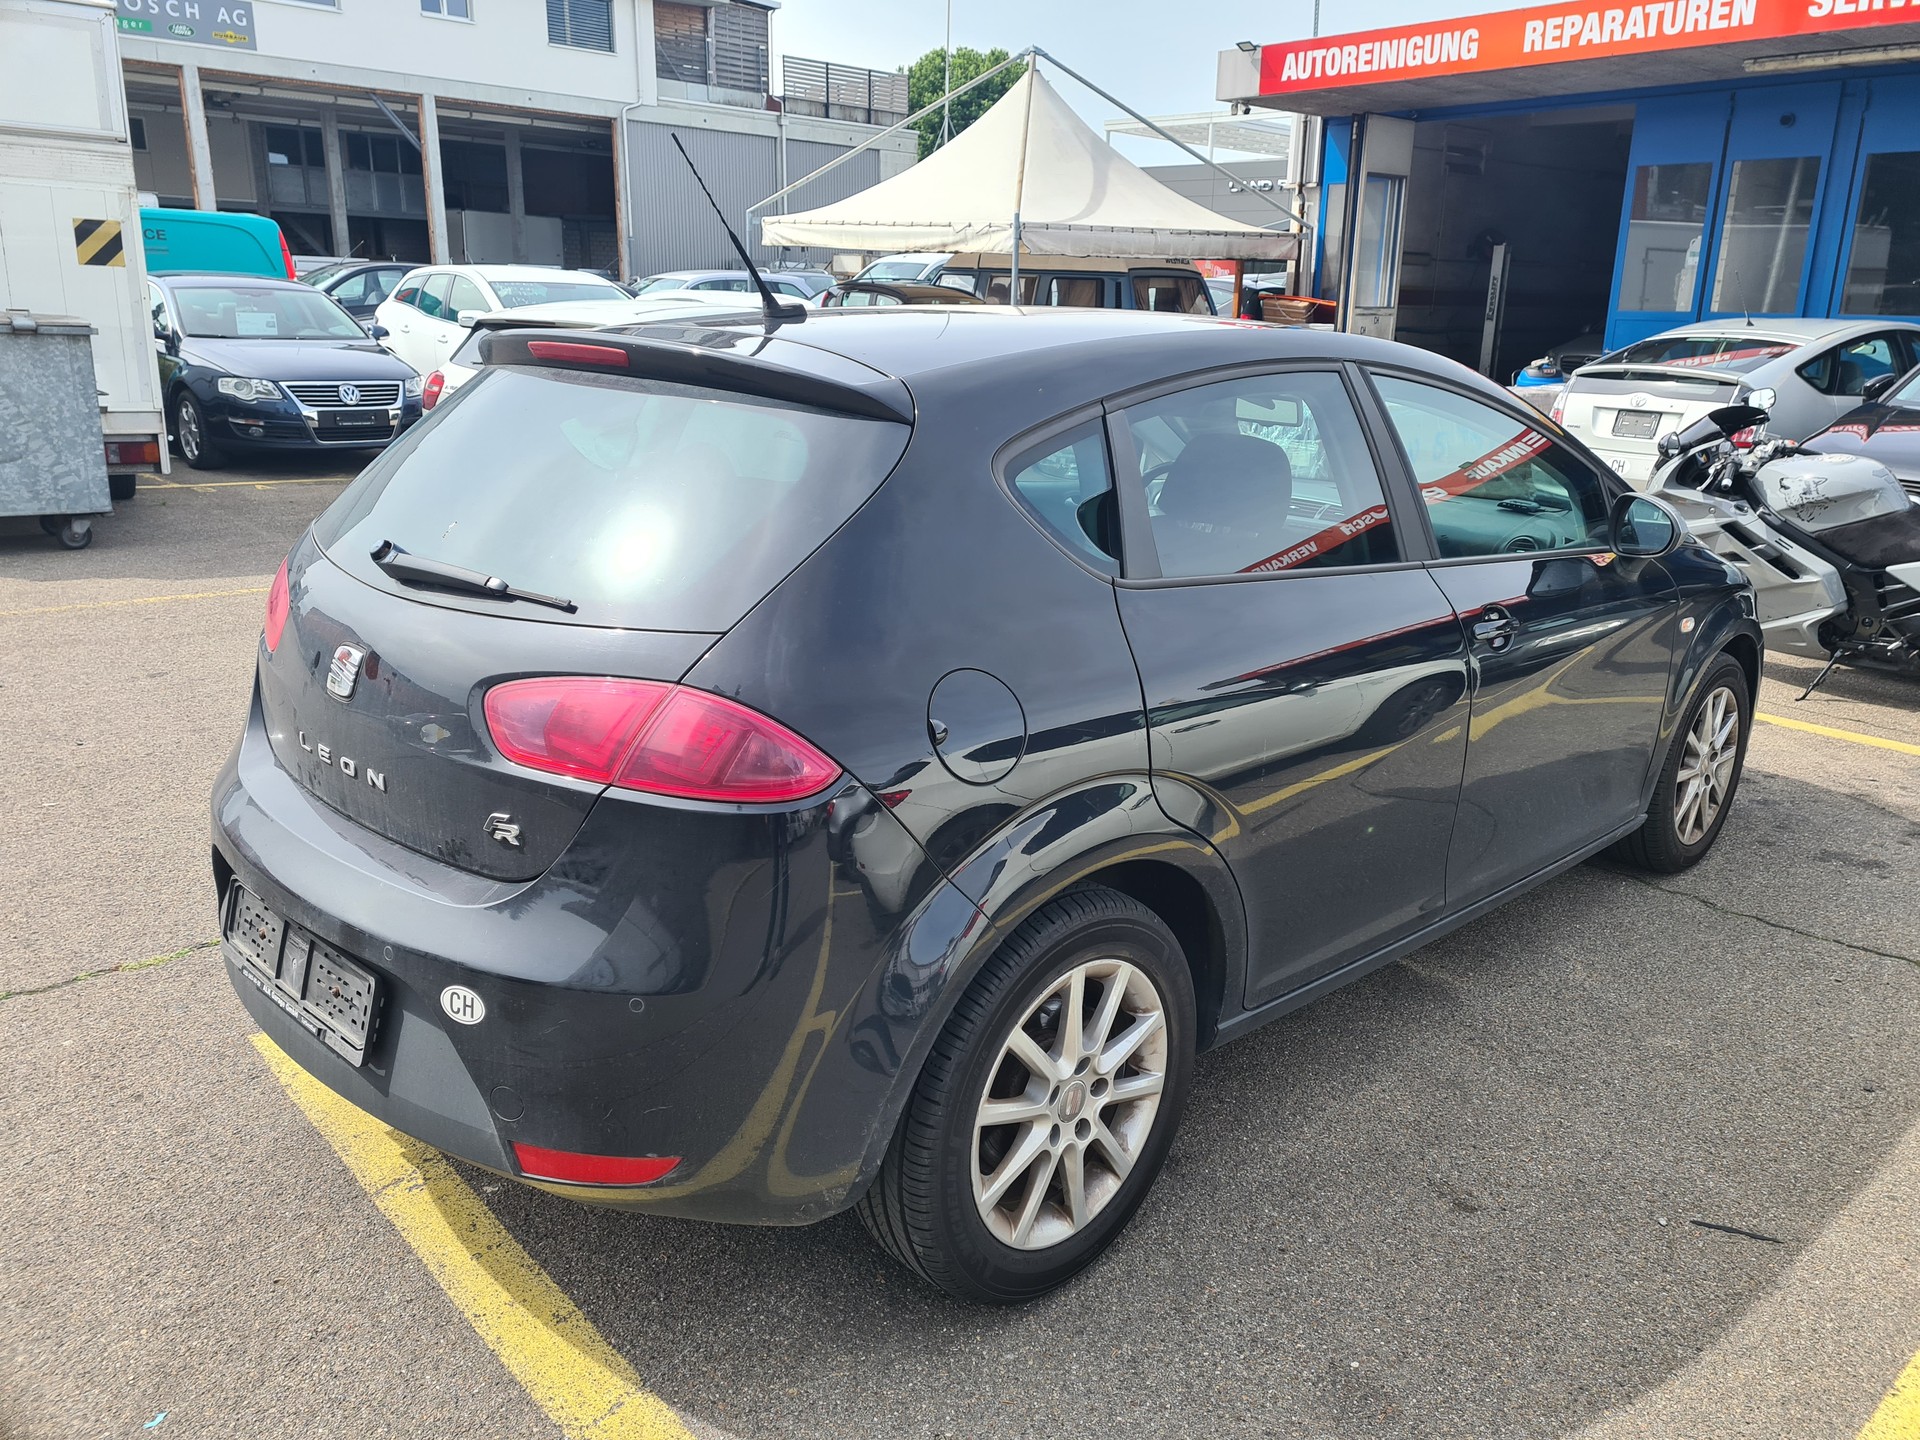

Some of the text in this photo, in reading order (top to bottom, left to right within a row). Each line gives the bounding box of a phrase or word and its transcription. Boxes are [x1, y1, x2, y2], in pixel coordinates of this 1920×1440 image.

[217, 7, 247, 26] AG
[1523, 0, 1757, 53] REPARATUREN
[1280, 28, 1479, 82] AUTOREINIGUNG
[143, 228, 167, 240] CE
[1611, 459, 1625, 473] CH
[299, 731, 387, 792] LEON
[482, 812, 521, 846] FR
[449, 991, 475, 1019] CH
